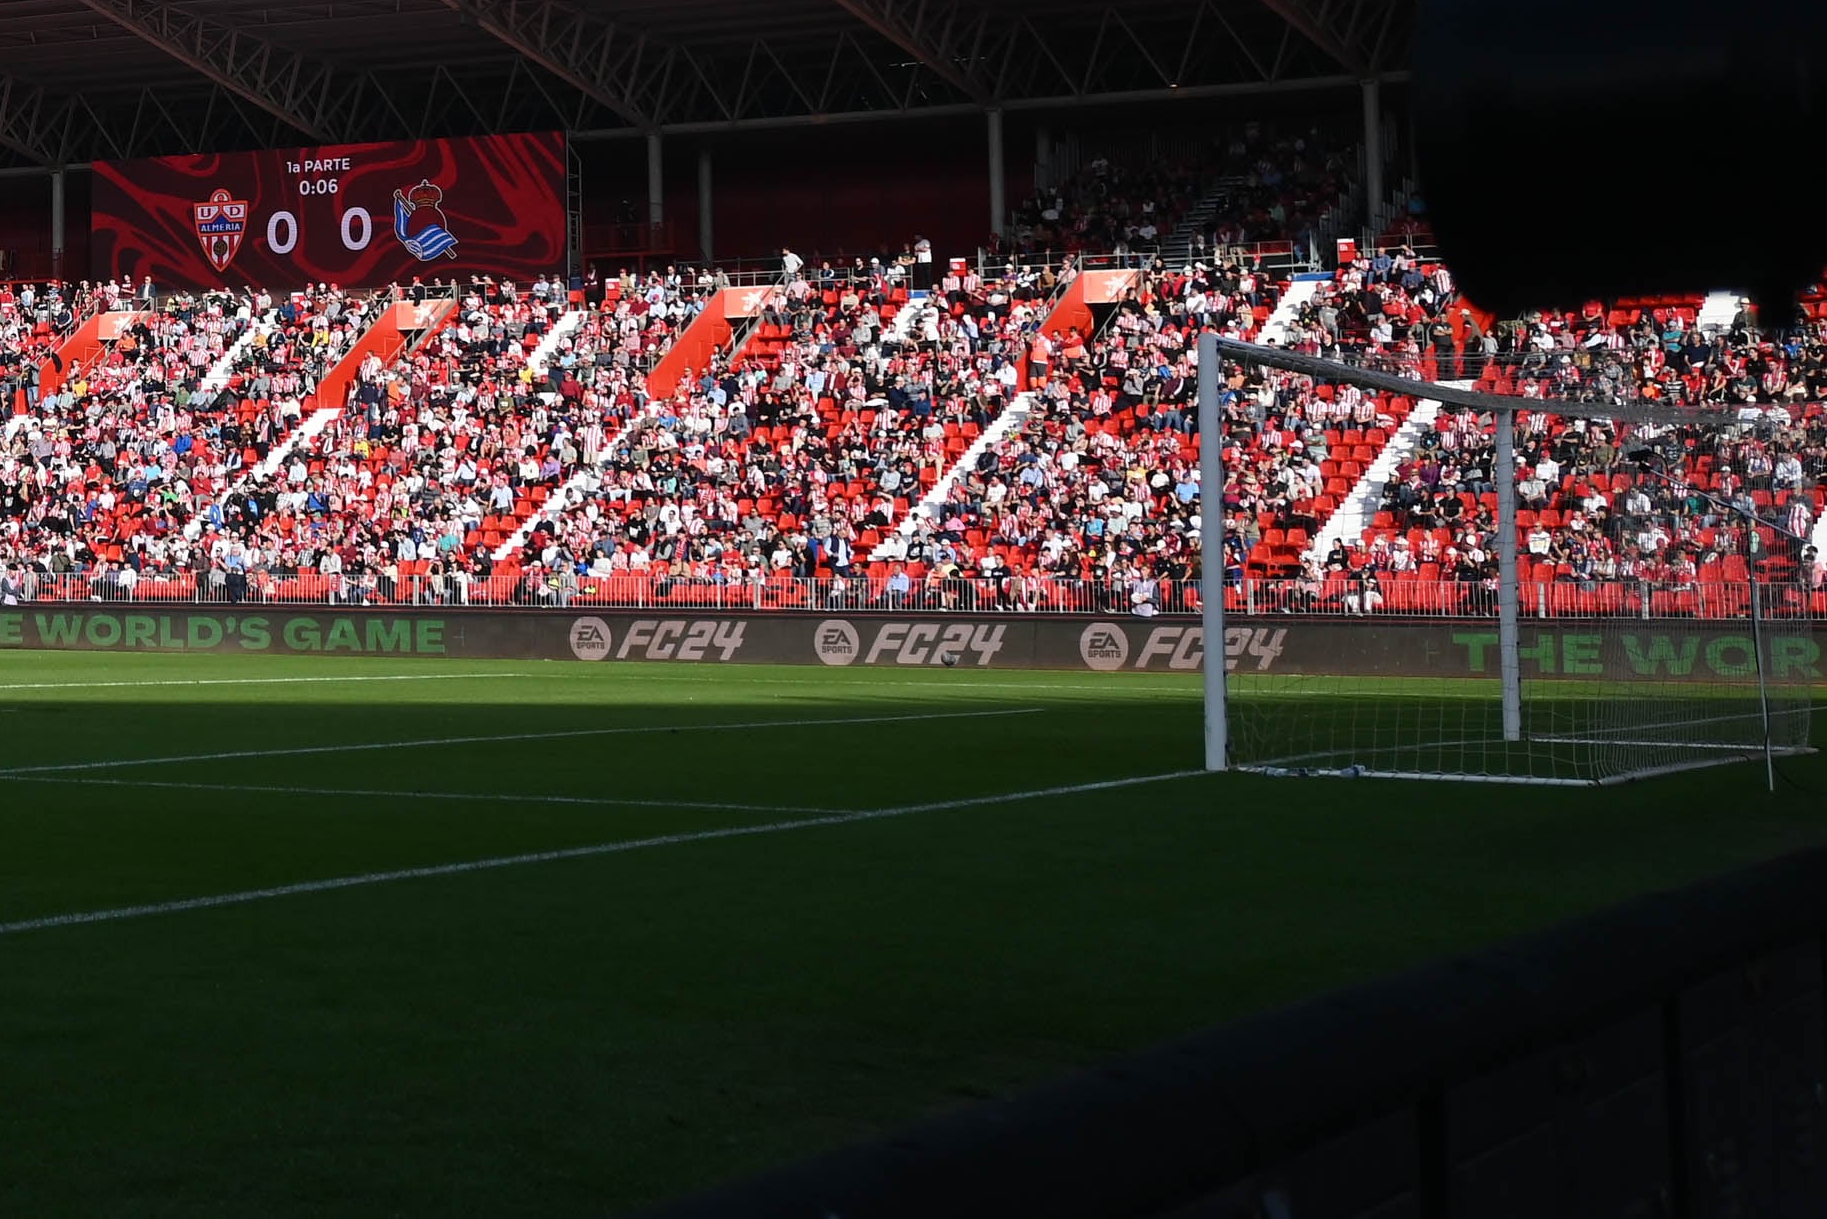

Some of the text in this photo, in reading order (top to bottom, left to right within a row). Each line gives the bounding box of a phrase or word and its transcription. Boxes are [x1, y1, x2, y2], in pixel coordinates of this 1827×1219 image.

[286, 157, 351, 173] 1a PARTE
[299, 178, 339, 196] 0:06
[200, 206, 241, 218] U D
[200, 223, 241, 232] ALMERIA
[267, 210, 298, 254] 0
[340, 206, 372, 251] 0
[35, 613, 271, 650] WORLD'S
[283, 616, 446, 653] GAME
[577, 625, 603, 642] EA
[616, 621, 747, 661] FC24
[822, 628, 851, 646] EA
[1089, 632, 1120, 650] EA
[575, 641, 605, 649] SPORTS
[821, 645, 853, 654] SPORTS
[865, 623, 1008, 666] FC24
[1087, 649, 1122, 658] SPORTS
[1453, 633, 1603, 674] THE
